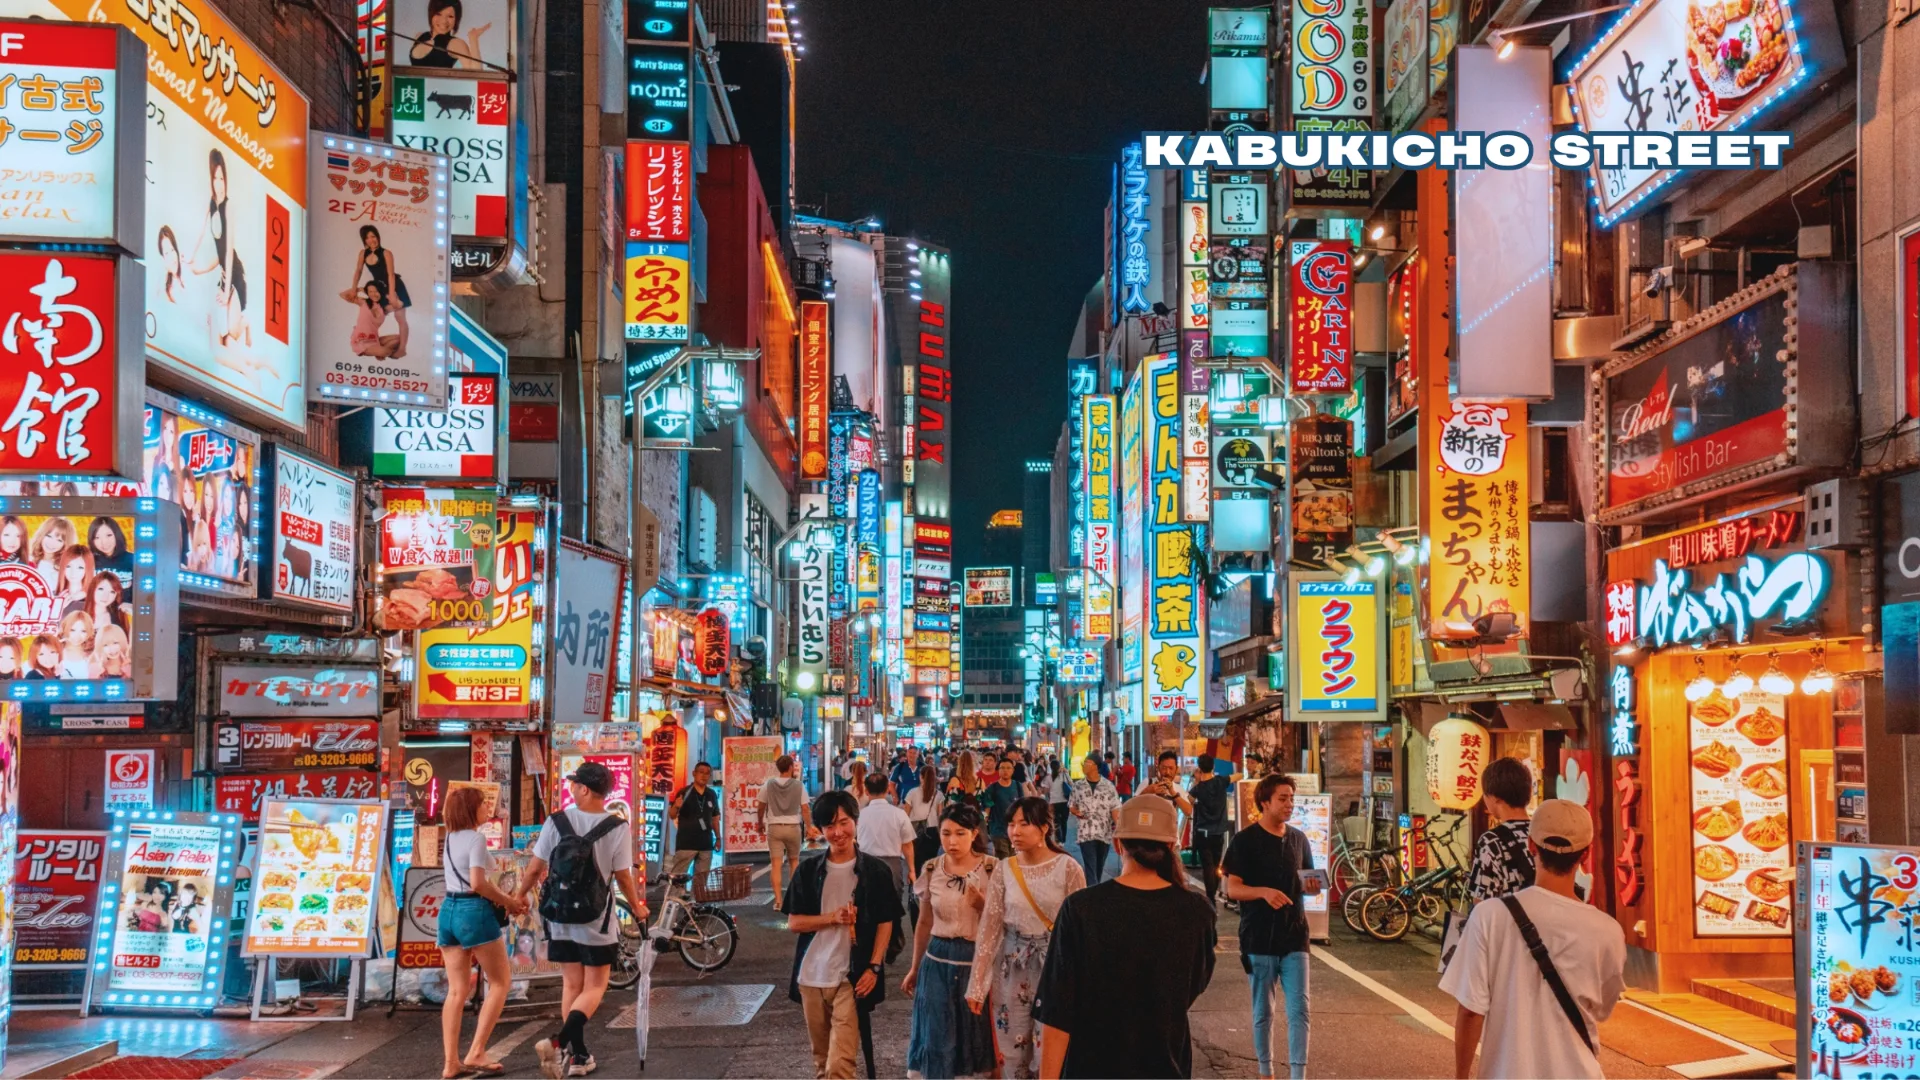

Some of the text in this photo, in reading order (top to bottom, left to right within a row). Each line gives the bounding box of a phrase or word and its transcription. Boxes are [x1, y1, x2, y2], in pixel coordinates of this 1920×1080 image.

[634, 60, 683, 71] Party Space
[401, 86, 418, 103] 肉
[1353, 60, 1367, 110] ゴッド
[397, 103, 421, 114] バル
[479, 92, 507, 105] イタリ
[201, 86, 275, 170] Massage
[652, 121, 666, 130] 3F
[351, 156, 429, 186] タイ古式
[1230, 176, 1250, 184] 5F
[327, 173, 430, 204] マッサージ
[647, 146, 666, 239] リフレッシュ
[672, 147, 683, 235] レンタルルーム ホステル
[328, 199, 356, 214] 2F
[630, 229, 641, 237] 2F
[1123, 143, 1150, 312] カラオケの鉄人
[649, 245, 668, 254] 1F
[1230, 239, 1249, 247] 4F
[1293, 244, 1310, 255] 3F
[1230, 302, 1249, 310] 3F
[1300, 251, 1348, 382] CARINA
[628, 325, 686, 338] 博多天神
[1306, 296, 1323, 380] カリーナ
[335, 362, 362, 373] 60分
[628, 357, 653, 377] Party
[326, 372, 429, 393] 03-3207-5527
[463, 380, 492, 394] イタリ
[808, 320, 820, 442] 個室ダイニング居酒屋
[468, 393, 488, 403] アン
[661, 418, 677, 427] B1
[1617, 384, 1678, 443] Real
[394, 430, 475, 453] CASA
[1302, 434, 1342, 444] BBQ 東京
[1444, 426, 1502, 459] 新宿
[1300, 446, 1345, 457] Walton's
[1091, 405, 1110, 520] まんが喫茶
[1465, 457, 1483, 472] の
[280, 462, 326, 489] ヘルシー
[279, 483, 315, 515] 肉バル
[861, 473, 877, 529] カラオケ
[1232, 492, 1250, 500] B1
[386, 498, 493, 518] 肉祭り開催中
[1487, 482, 1503, 585] 九州のうまかもん
[1504, 480, 1521, 587] 博多もつ鍋 水炊き
[1668, 511, 1796, 568] 旭川味噌ラーメン
[1312, 545, 1335, 560] 2F
[1441, 479, 1486, 622] まっちゃん
[1321, 599, 1355, 695] クラウン
[455, 686, 520, 701] 受付3F
[1152, 695, 1196, 709] マンボー
[1612, 665, 1634, 756] 角煮
[243, 732, 311, 749] レンタルルーム
[313, 726, 377, 752] Eden
[1454, 733, 1482, 801] 鉄なべ餃子
[130, 842, 215, 864] Asian Relax
[29, 860, 97, 882] ルーム
[128, 865, 165, 876] Welcome
[16, 949, 86, 961] 03-3203-9666
[1815, 911, 1829, 1045] 継ぎ足された秘伝のタレ
[1869, 1036, 1903, 1049] 串焼き
[1869, 1053, 1916, 1070] 串揚げ
